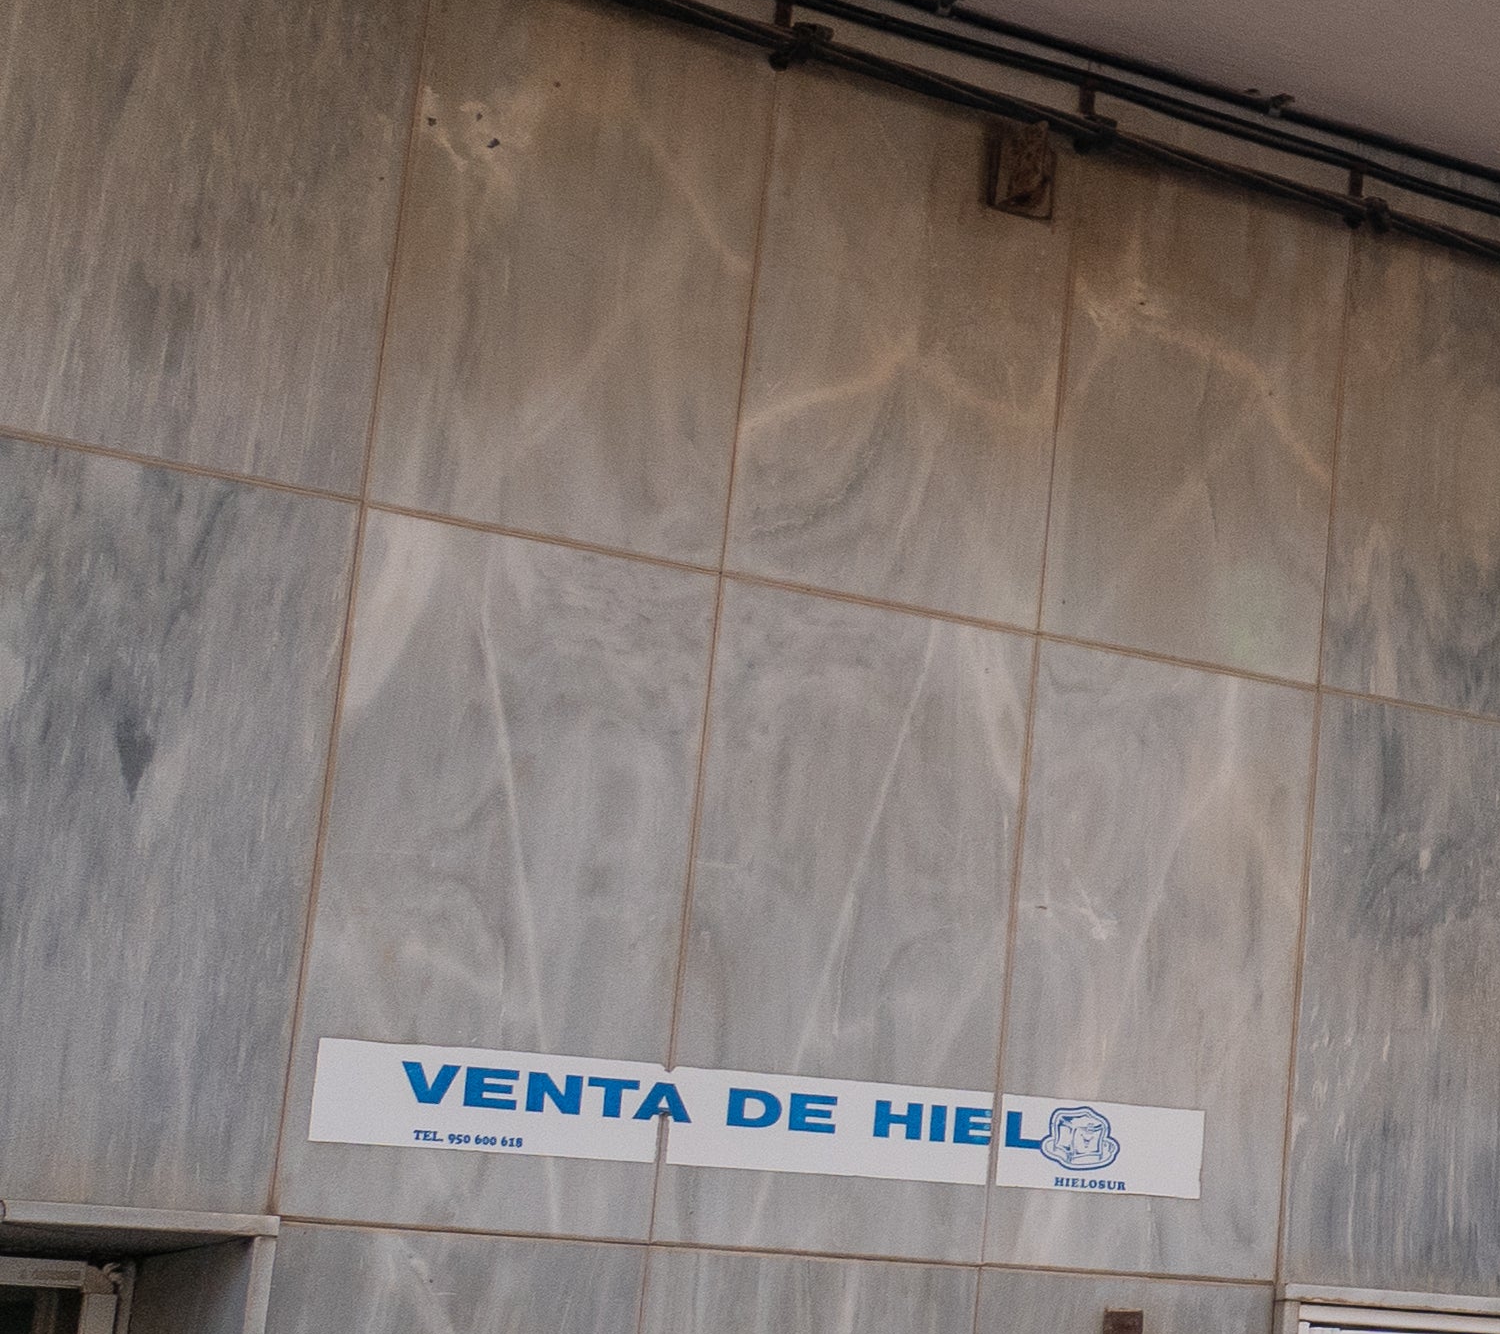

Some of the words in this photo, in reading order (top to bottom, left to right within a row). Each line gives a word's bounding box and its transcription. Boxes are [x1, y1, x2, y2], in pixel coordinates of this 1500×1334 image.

[402, 1060, 692, 1123] VENTA
[725, 1087, 838, 1135] DE
[413, 1129, 443, 1142] TEL.
[448, 1133, 471, 1144] 950
[474, 1134, 497, 1146] 600
[1054, 1176, 1126, 1191] HIELOSUR
